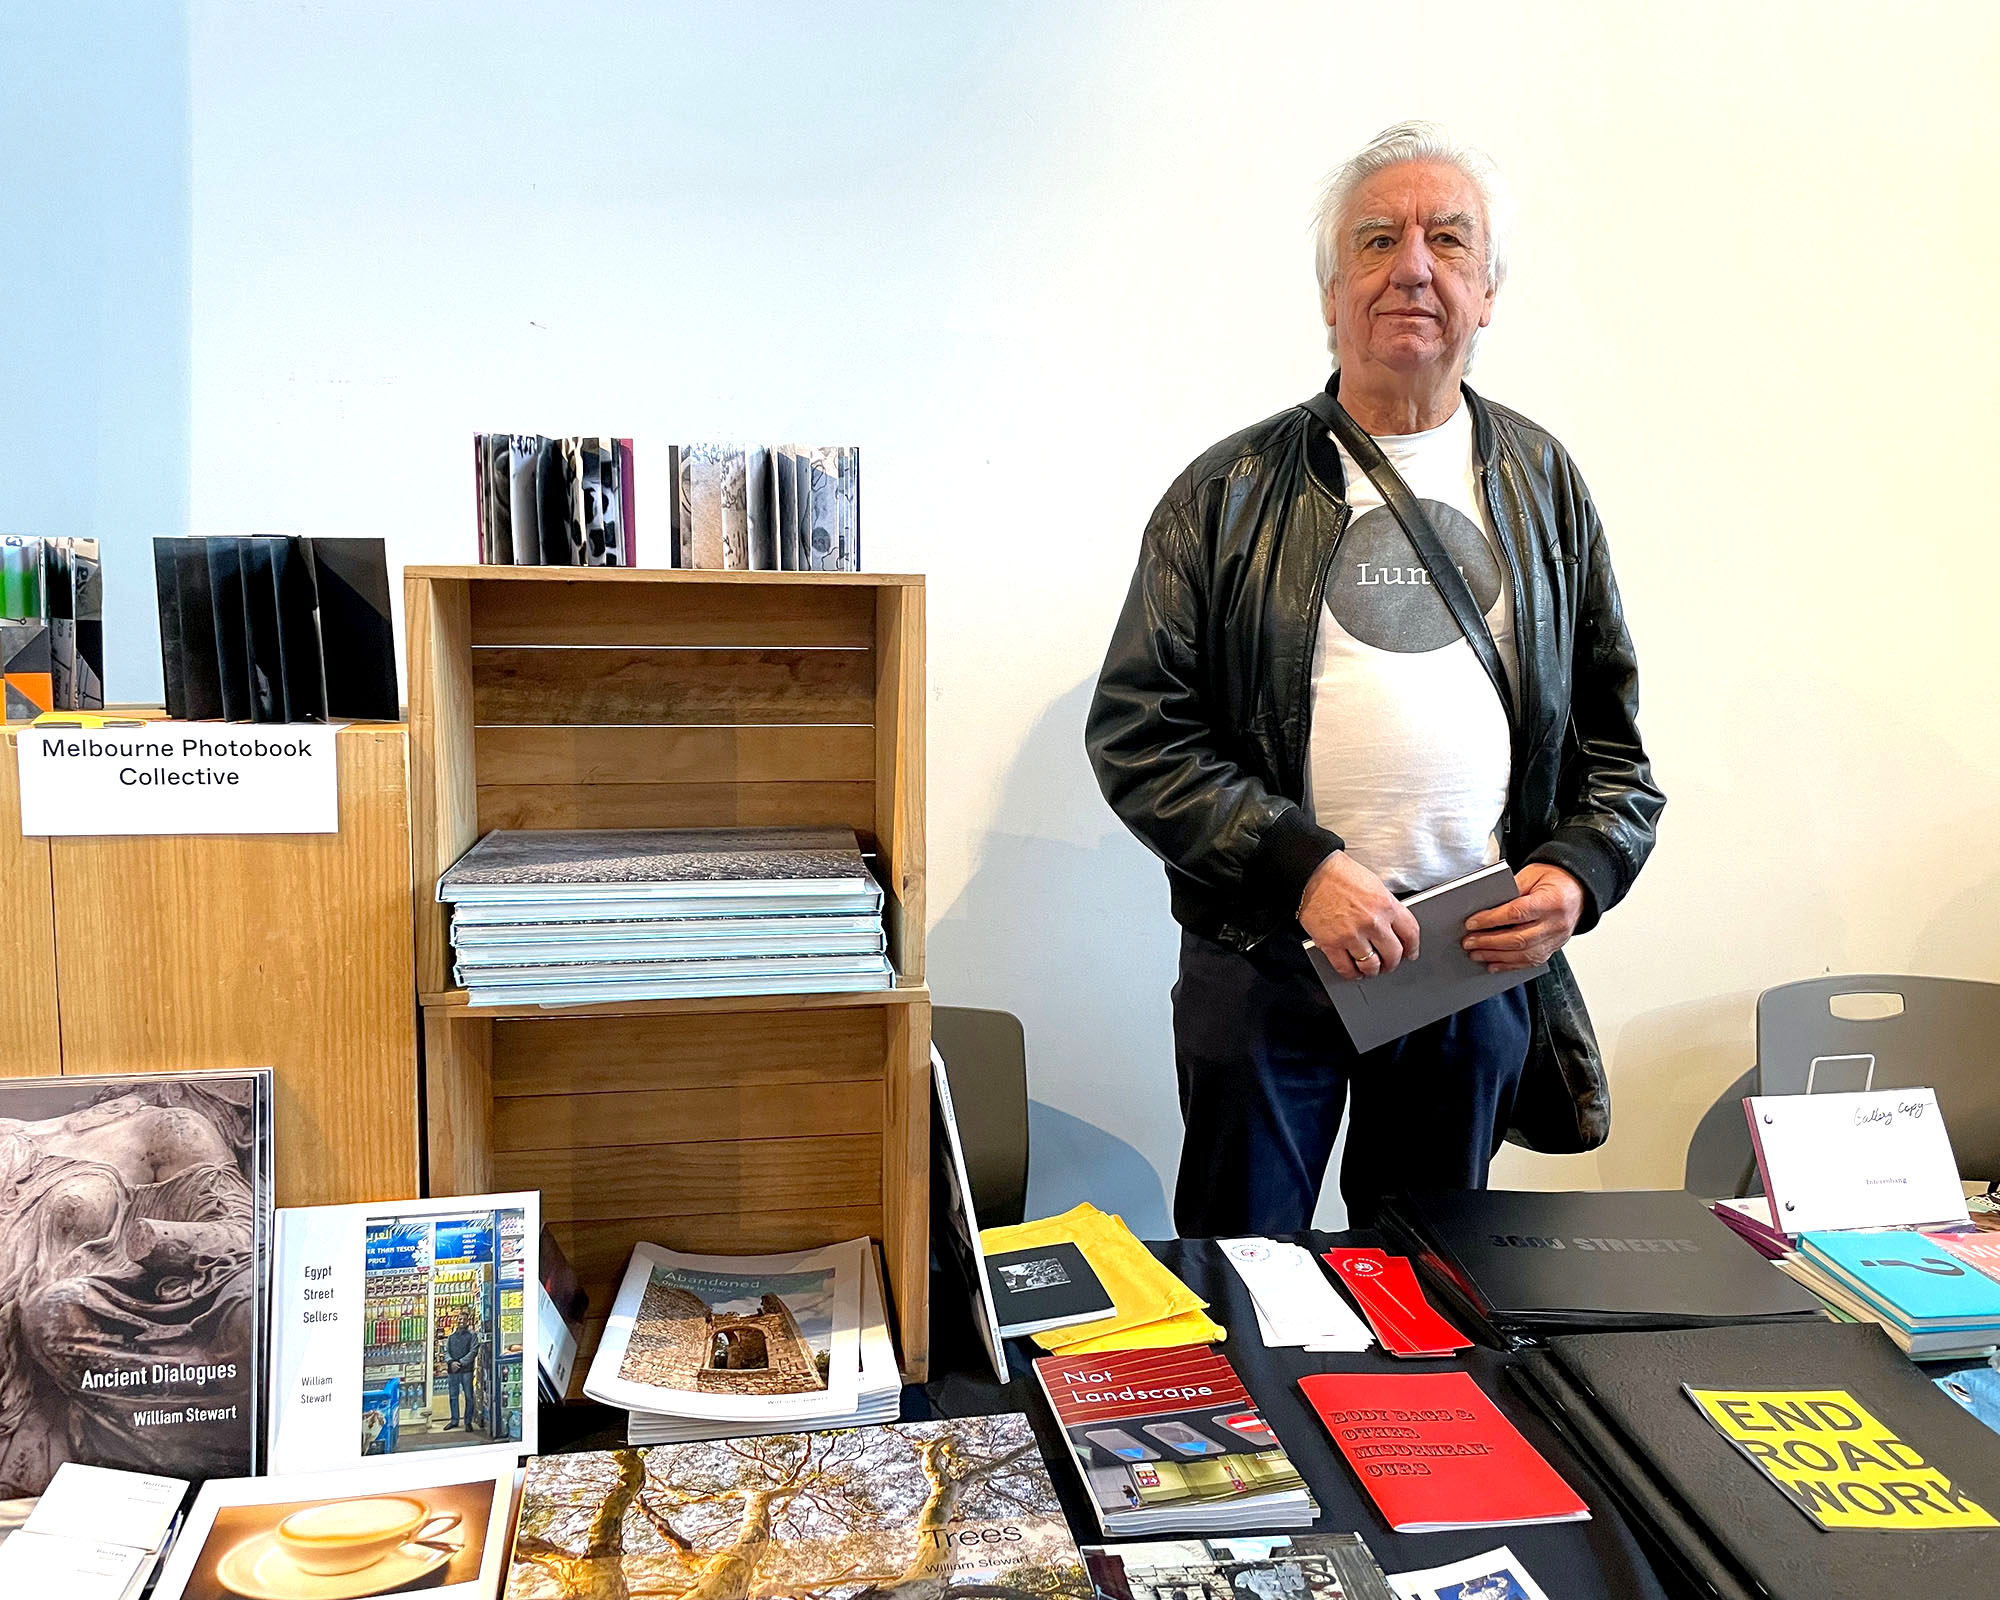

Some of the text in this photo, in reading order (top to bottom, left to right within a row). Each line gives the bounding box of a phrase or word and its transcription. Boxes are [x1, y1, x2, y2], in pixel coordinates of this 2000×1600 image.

[42, 739, 312, 757] Melbourne Photobook
[119, 767, 240, 785] Collective
[396, 1245, 416, 1253] TESCO
[1572, 1237, 1700, 1251] STREETS
[304, 1265, 332, 1281] Egypt
[664, 1272, 761, 1288] Abandoned
[304, 1288, 334, 1300] Street
[303, 1310, 338, 1323] Sellers
[81, 1363, 237, 1389] Ancient Dialogues
[301, 1376, 333, 1387] William
[1063, 1370, 1113, 1385] Not
[301, 1393, 332, 1404] Stewart
[1072, 1385, 1213, 1404] Landscape
[134, 1405, 237, 1426] William Stewart
[1329, 1409, 1476, 1424] BODY BAGS &
[1716, 1400, 1862, 1431] END
[1341, 1427, 1421, 1440] OTHER
[1736, 1440, 1927, 1471] ROAD
[1365, 1463, 1432, 1477] OURS
[1778, 1480, 1972, 1515] WORK
[923, 1526, 1022, 1549] Trees
[926, 1555, 1030, 1573] William Stewart
